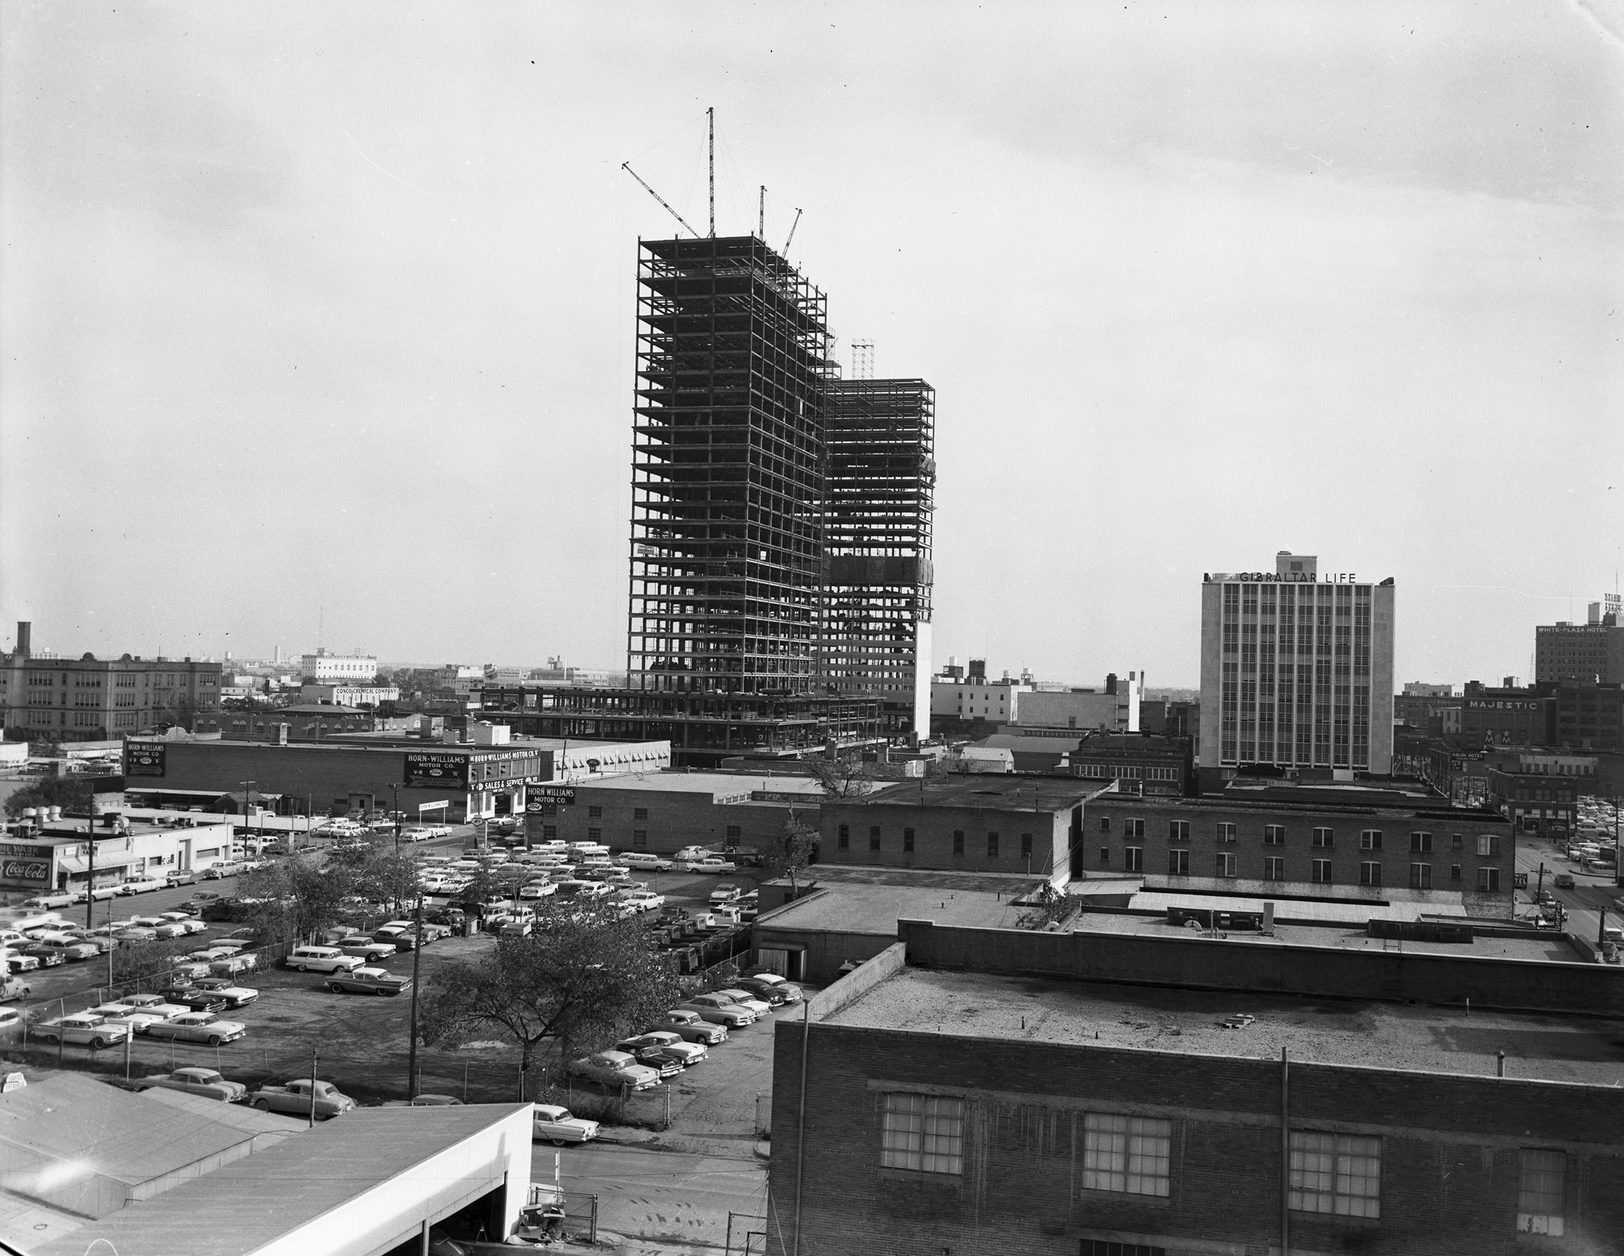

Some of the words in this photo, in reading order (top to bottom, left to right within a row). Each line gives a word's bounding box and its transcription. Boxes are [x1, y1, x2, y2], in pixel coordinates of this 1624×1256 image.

[1239, 572, 1317, 583] GIBRALTAR
[1325, 573, 1356, 584] LIFE
[1469, 700, 1537, 710] MAJESTIC
[512, 751, 528, 760] MOTOR
[484, 780, 501, 790] SALES
[501, 780, 505, 788] &
[506, 778, 524, 787] SERVICE
[527, 787, 545, 796] HORN
[546, 788, 574, 798] WILLIAMS
[6, 862, 47, 879] Coca-Cola
